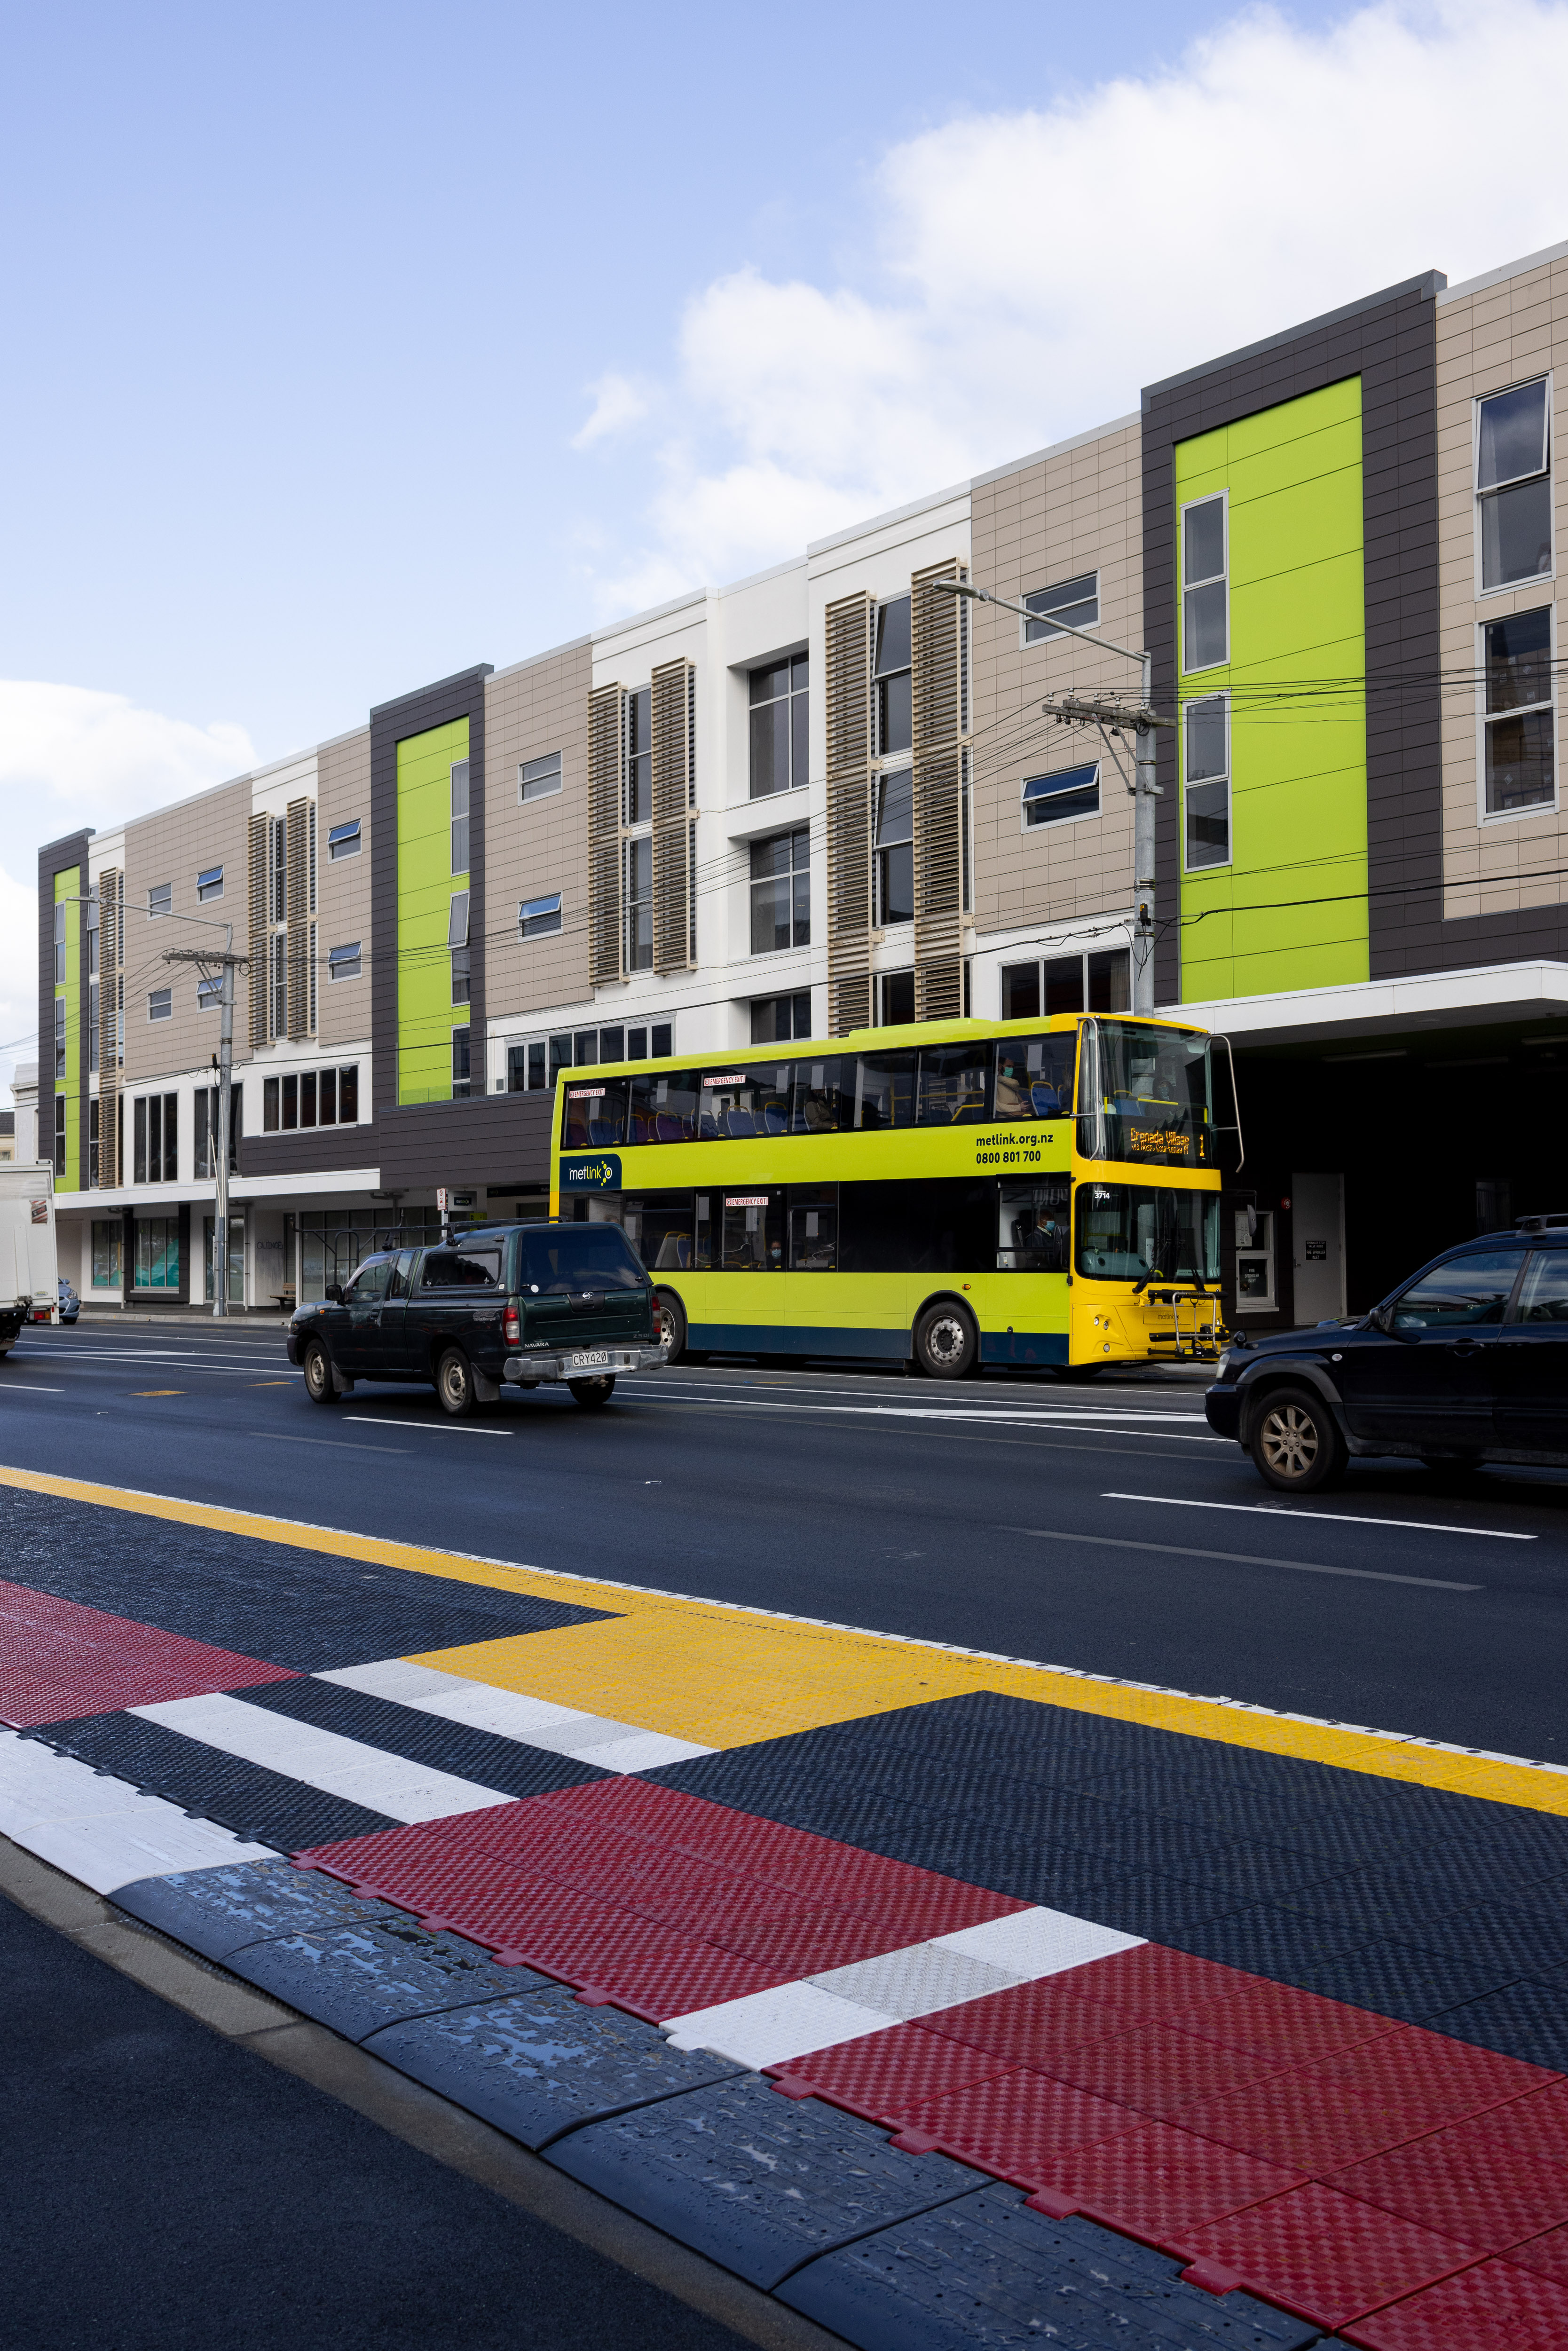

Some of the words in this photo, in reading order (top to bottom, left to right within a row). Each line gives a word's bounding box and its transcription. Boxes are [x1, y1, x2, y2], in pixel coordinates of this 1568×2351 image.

[976, 1133, 1053, 1146] metlink.org.nz
[1131, 1128, 1164, 1144] Grenada
[1166, 1131, 1190, 1146] Village
[1156, 1144, 1182, 1154] Courtenay
[1199, 1134, 1205, 1157] 1
[976, 1152, 1000, 1164] 0800
[1003, 1151, 1020, 1163] 801
[1023, 1150, 1040, 1162] 700
[569, 1166, 602, 1180] metlink
[574, 1352, 606, 1365] CRY420
